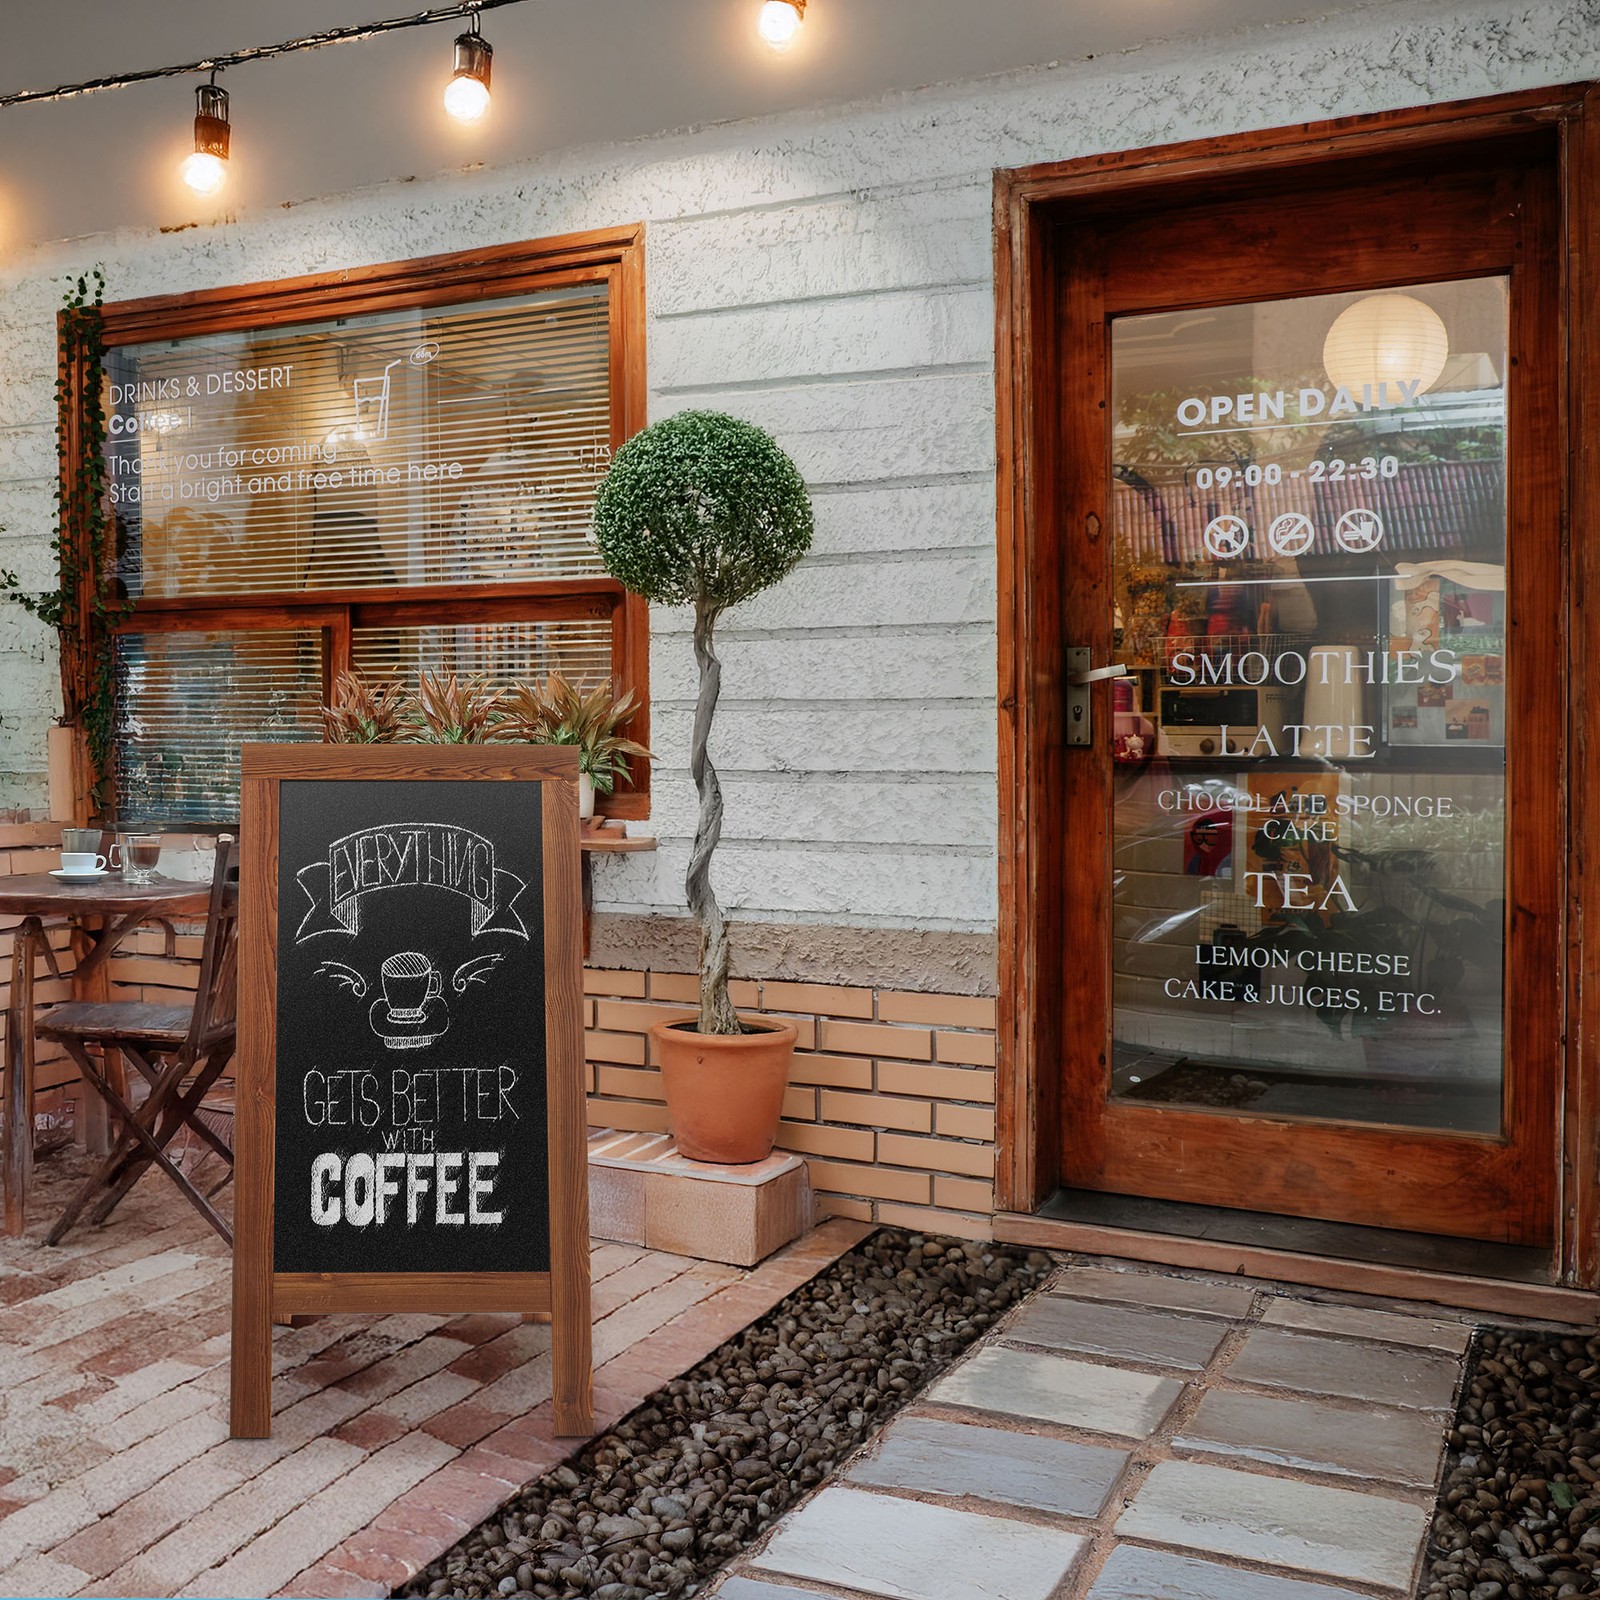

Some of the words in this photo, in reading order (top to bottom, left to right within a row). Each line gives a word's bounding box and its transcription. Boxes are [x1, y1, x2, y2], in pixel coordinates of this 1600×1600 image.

[109, 378, 181, 405] DRINKS
[186, 376, 200, 397] &
[206, 365, 294, 395] DESSERT
[1177, 390, 1285, 427] OPEN
[1300, 379, 1421, 417] DAILY
[108, 410, 181, 435] Coffee
[109, 451, 169, 476] Thank
[173, 452, 212, 475] you
[217, 446, 247, 467] for
[252, 439, 338, 465] coming
[1196, 463, 1282, 489] 09:00
[1309, 455, 1399, 482] 22:30
[109, 481, 156, 504] Start
[161, 483, 174, 500] a
[180, 474, 242, 502] bright
[248, 470, 292, 494] and
[297, 468, 343, 491] free
[349, 465, 401, 487] time
[407, 461, 463, 482] here
[1170, 649, 1457, 686] SMOOTHIES
[1219, 724, 1377, 758] LATTE
[1157, 789, 1327, 816] CHOCOLATE
[1334, 793, 1454, 818] SPONGE
[1263, 819, 1338, 842] CAKE
[333, 830, 491, 902] EVERYTHING
[1243, 871, 1359, 912] TEA
[1195, 945, 1289, 969] LEMON
[1297, 949, 1412, 976] CHEESE
[1164, 977, 1236, 1003] CAKE
[1244, 983, 1261, 1003] &
[1266, 985, 1368, 1013] JUICES,
[1378, 991, 1443, 1015] ETC.
[303, 1068, 380, 1127] GETS
[392, 1065, 520, 1127] BETTER
[310, 1150, 504, 1227] COFFEE
